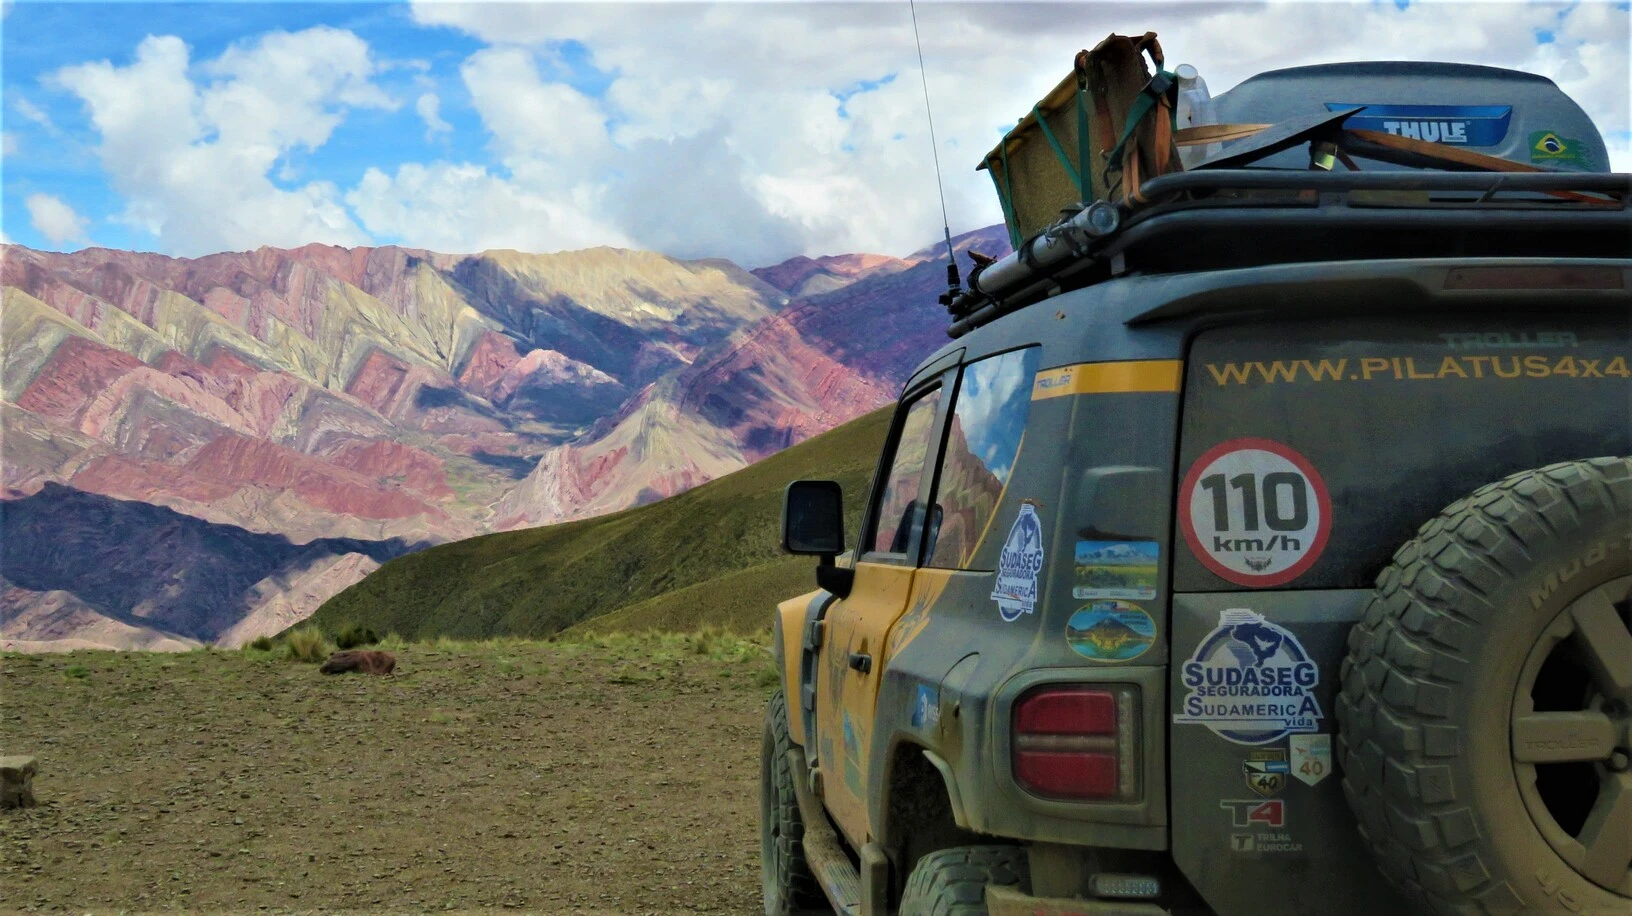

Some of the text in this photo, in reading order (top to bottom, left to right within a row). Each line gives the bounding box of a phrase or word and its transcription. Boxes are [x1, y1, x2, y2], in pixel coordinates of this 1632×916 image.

[1383, 121, 1467, 143] THULE
[1438, 332, 1579, 348] TROLLER
[1206, 355, 1631, 386] WWW.PILATUS4x4
[1199, 472, 1309, 532] 110
[1213, 535, 1301, 552] km/h
[1001, 547, 1042, 571] SUDASEG
[1000, 567, 1034, 580] SEGURADORA
[1185, 662, 1316, 687] SUDASEG
[1197, 685, 1303, 697] SEGURADORA
[1187, 696, 1319, 716] SUDAMERICA
[1284, 717, 1313, 727] vida
[1299, 761, 1323, 776] 40
[1257, 776, 1278, 790] 40
[1220, 799, 1284, 827] T4
